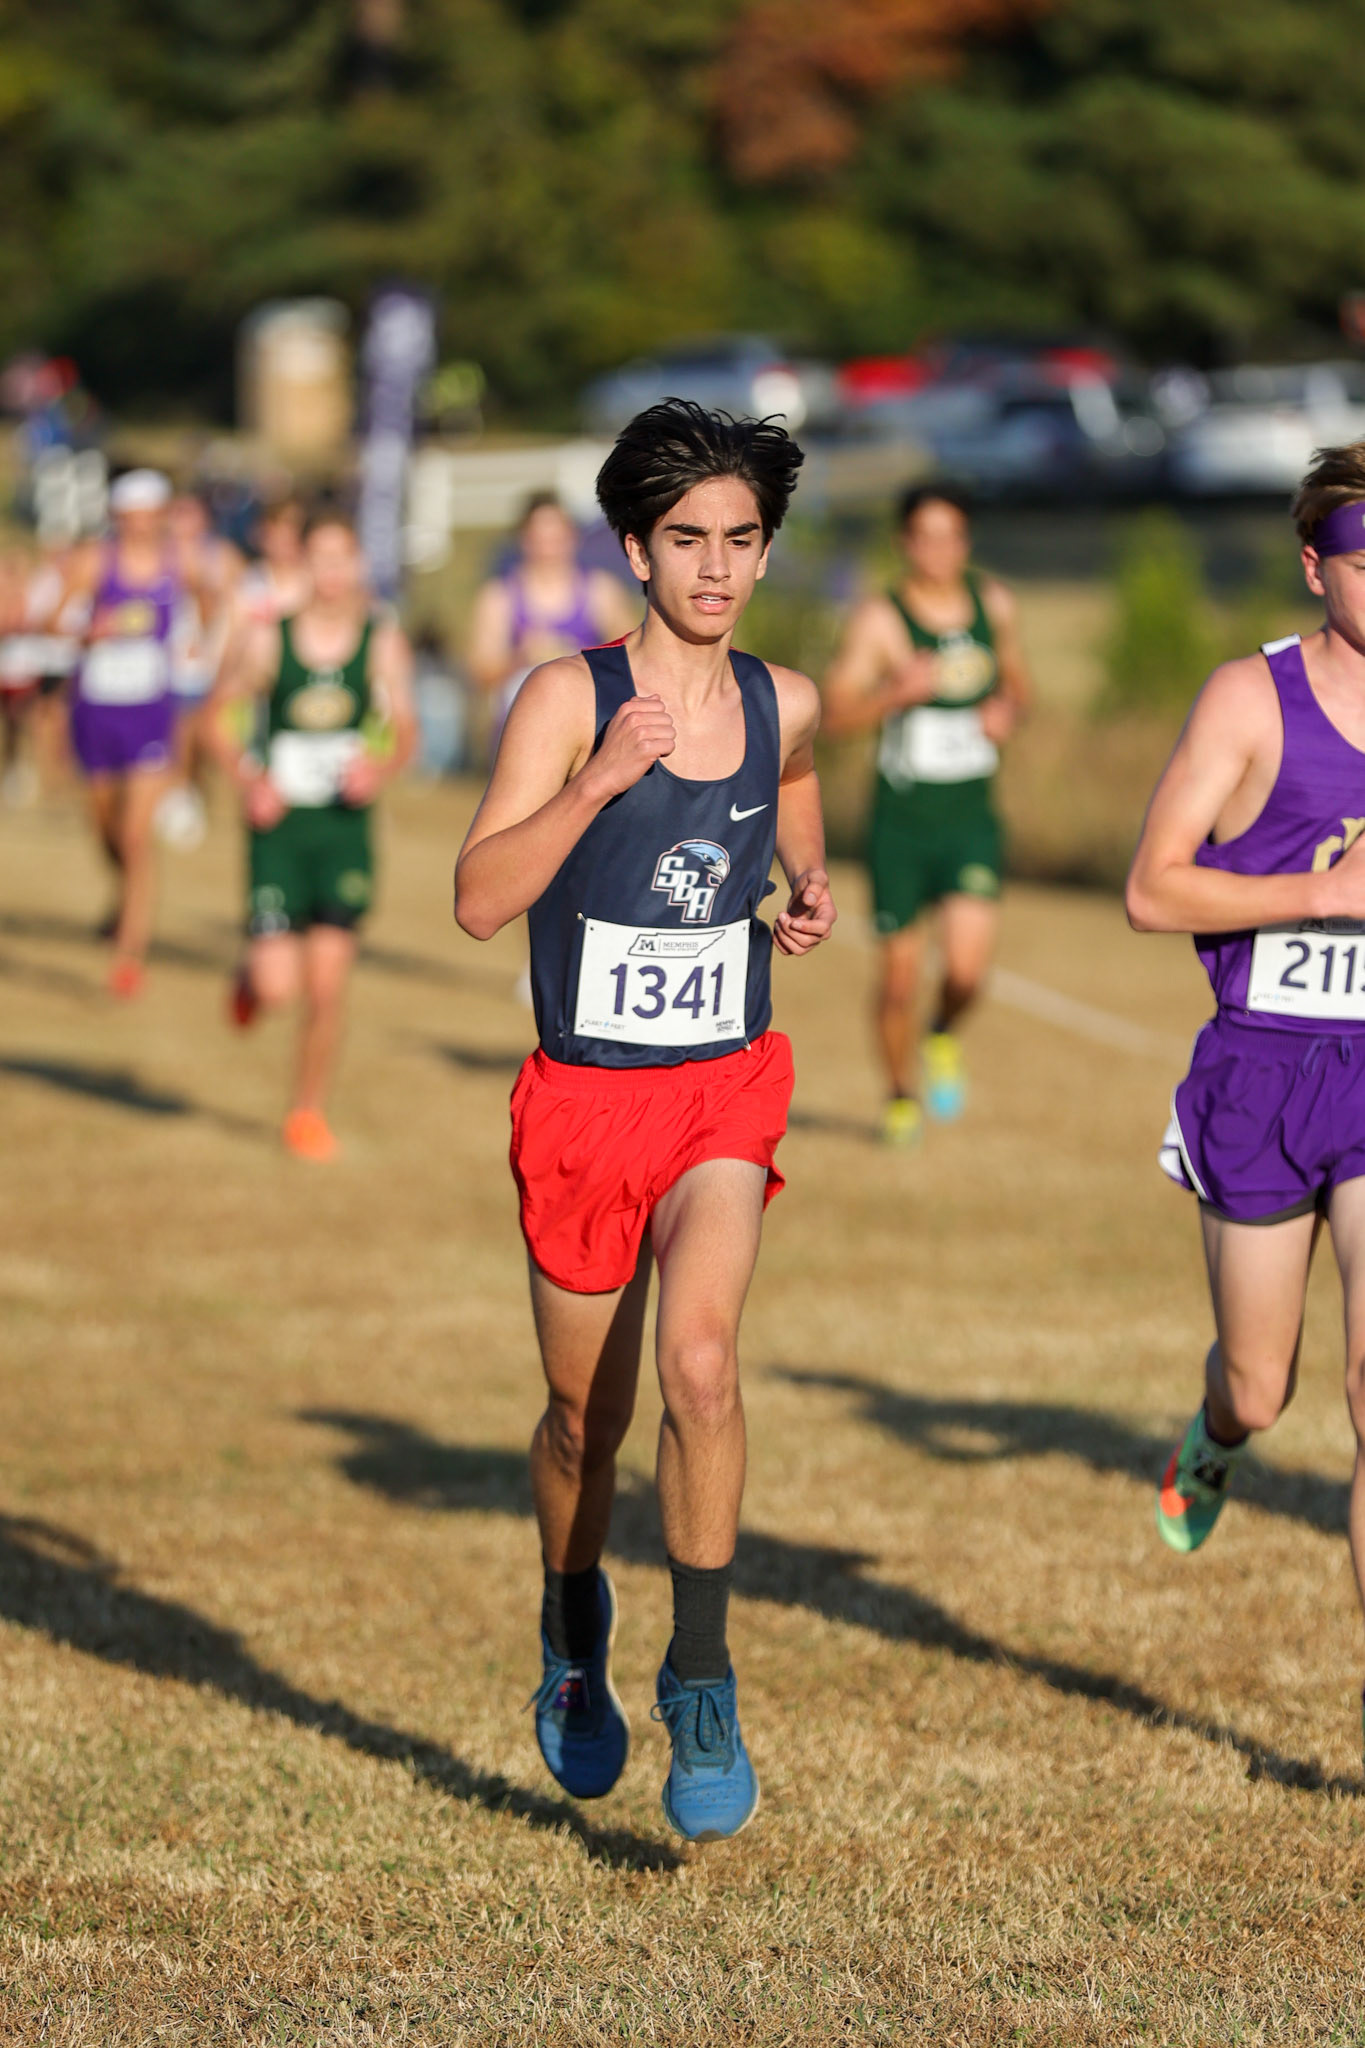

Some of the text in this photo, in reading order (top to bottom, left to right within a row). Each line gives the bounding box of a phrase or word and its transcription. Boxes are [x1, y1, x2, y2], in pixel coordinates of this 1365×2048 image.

[656, 856, 716, 920] SBA
[638, 939, 656, 951] M
[1279, 940, 1365, 994] 211
[610, 962, 724, 1019] 1341
